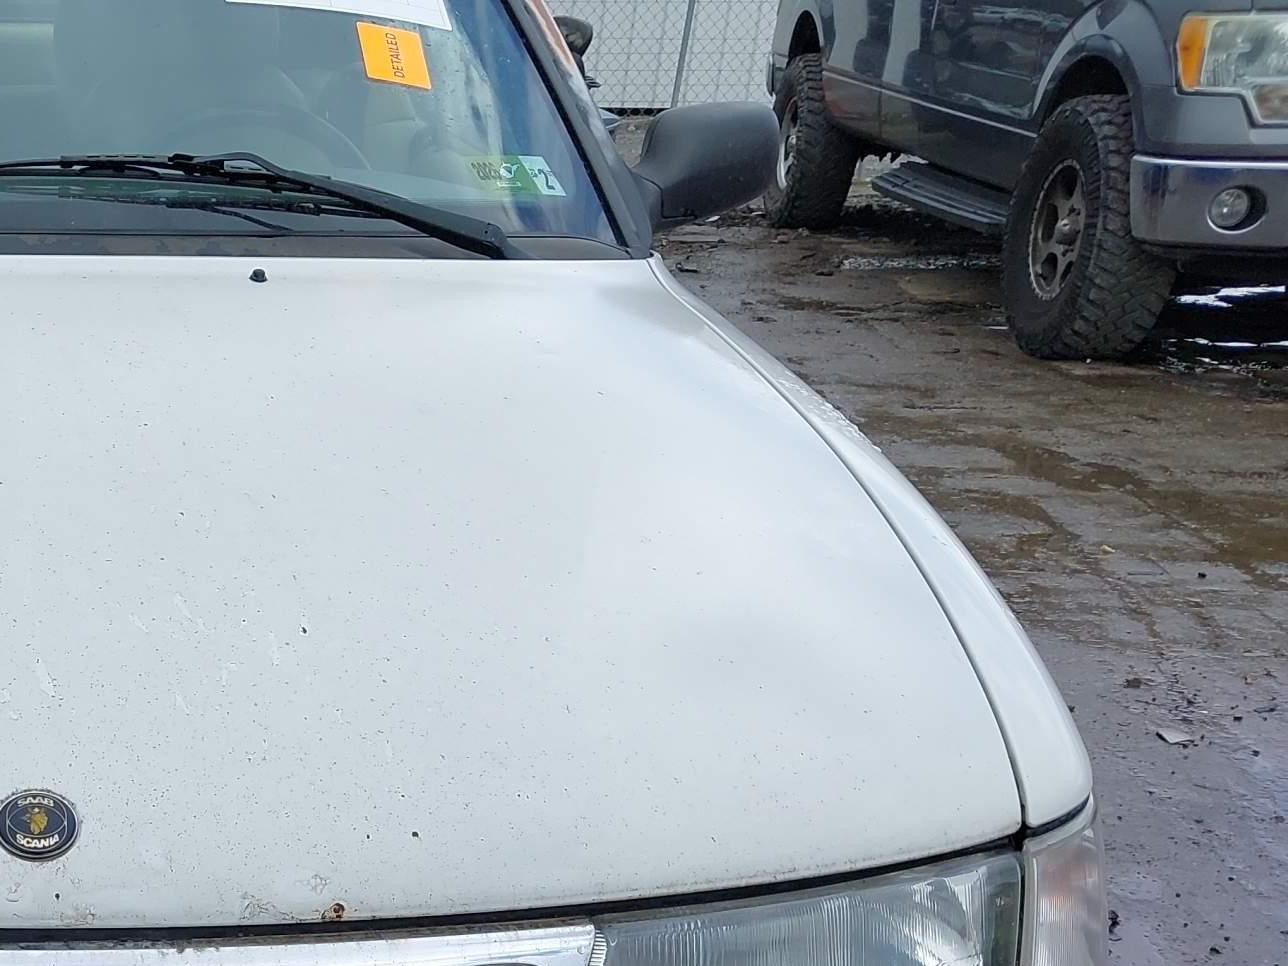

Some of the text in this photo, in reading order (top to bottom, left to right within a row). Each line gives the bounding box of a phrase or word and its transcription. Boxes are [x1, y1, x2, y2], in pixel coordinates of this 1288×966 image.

[385, 32, 405, 78] DETAILED
[17, 796, 55, 807] SAAB
[16, 833, 60, 848] SCANIA
